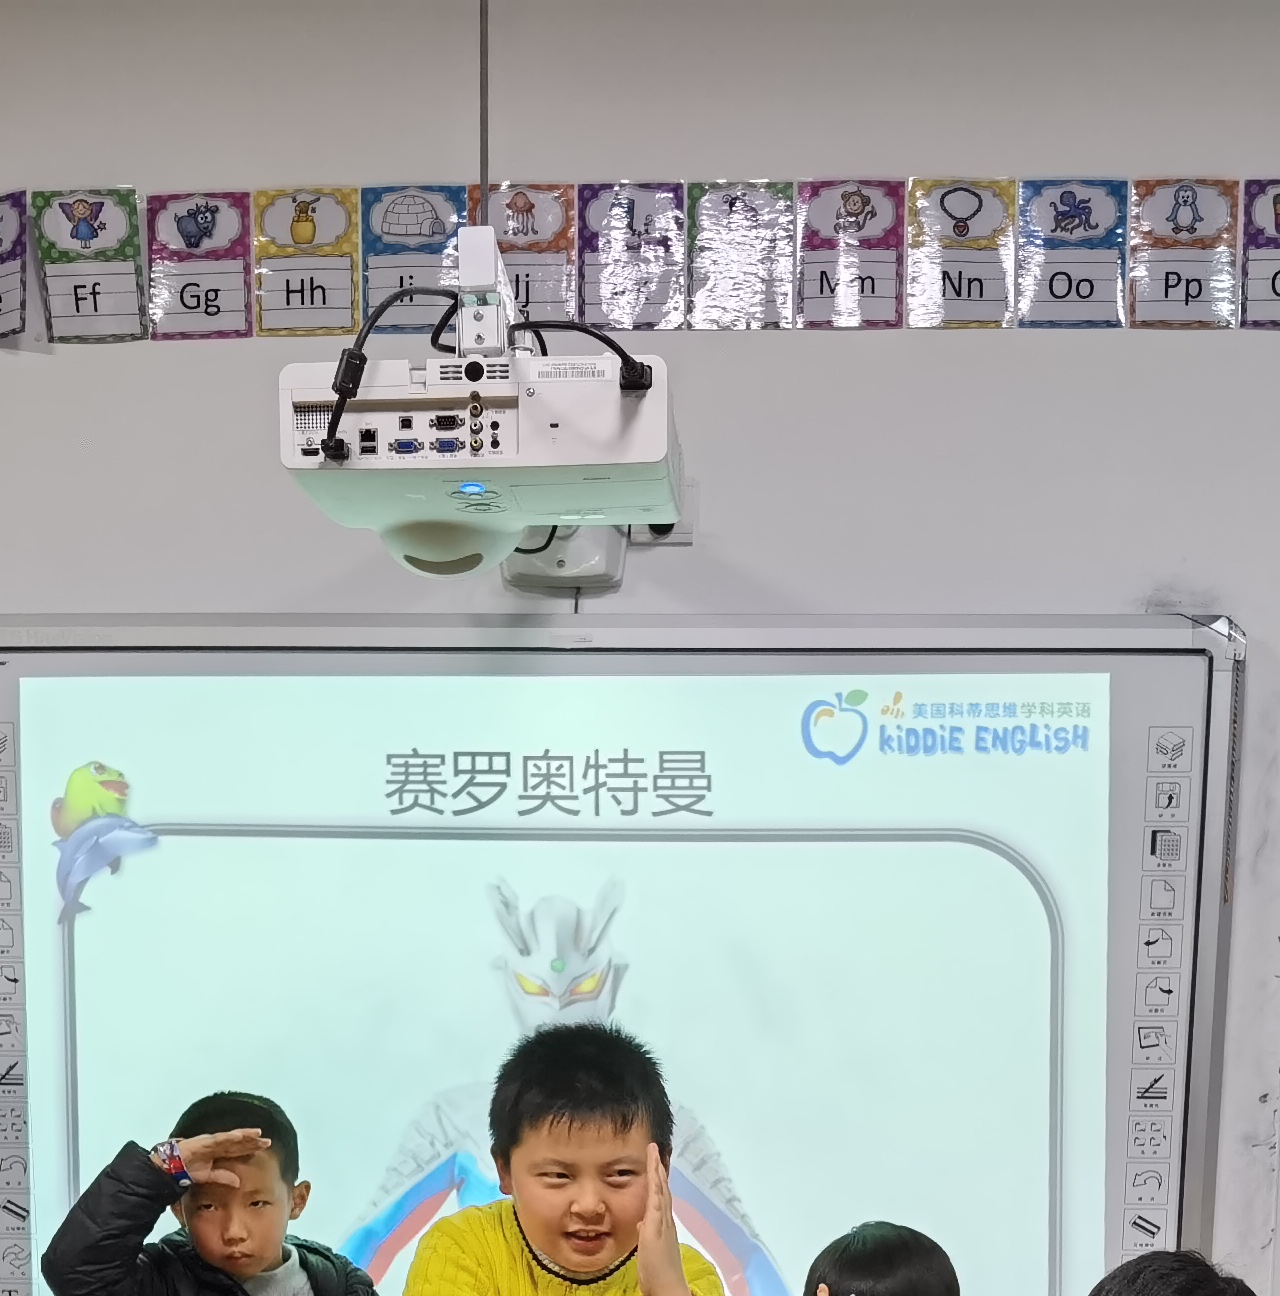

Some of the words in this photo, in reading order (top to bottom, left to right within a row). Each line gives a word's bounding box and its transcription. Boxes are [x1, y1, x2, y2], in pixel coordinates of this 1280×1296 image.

[74, 284, 101, 313] Ff
[180, 282, 220, 316] Gg
[287, 278, 327, 306] Hh
[942, 269, 984, 299] Nn
[1047, 271, 1095, 301] Oo
[1163, 270, 1202, 306] Pp
[384, 746, 715, 819] 赛罗奥特曼
